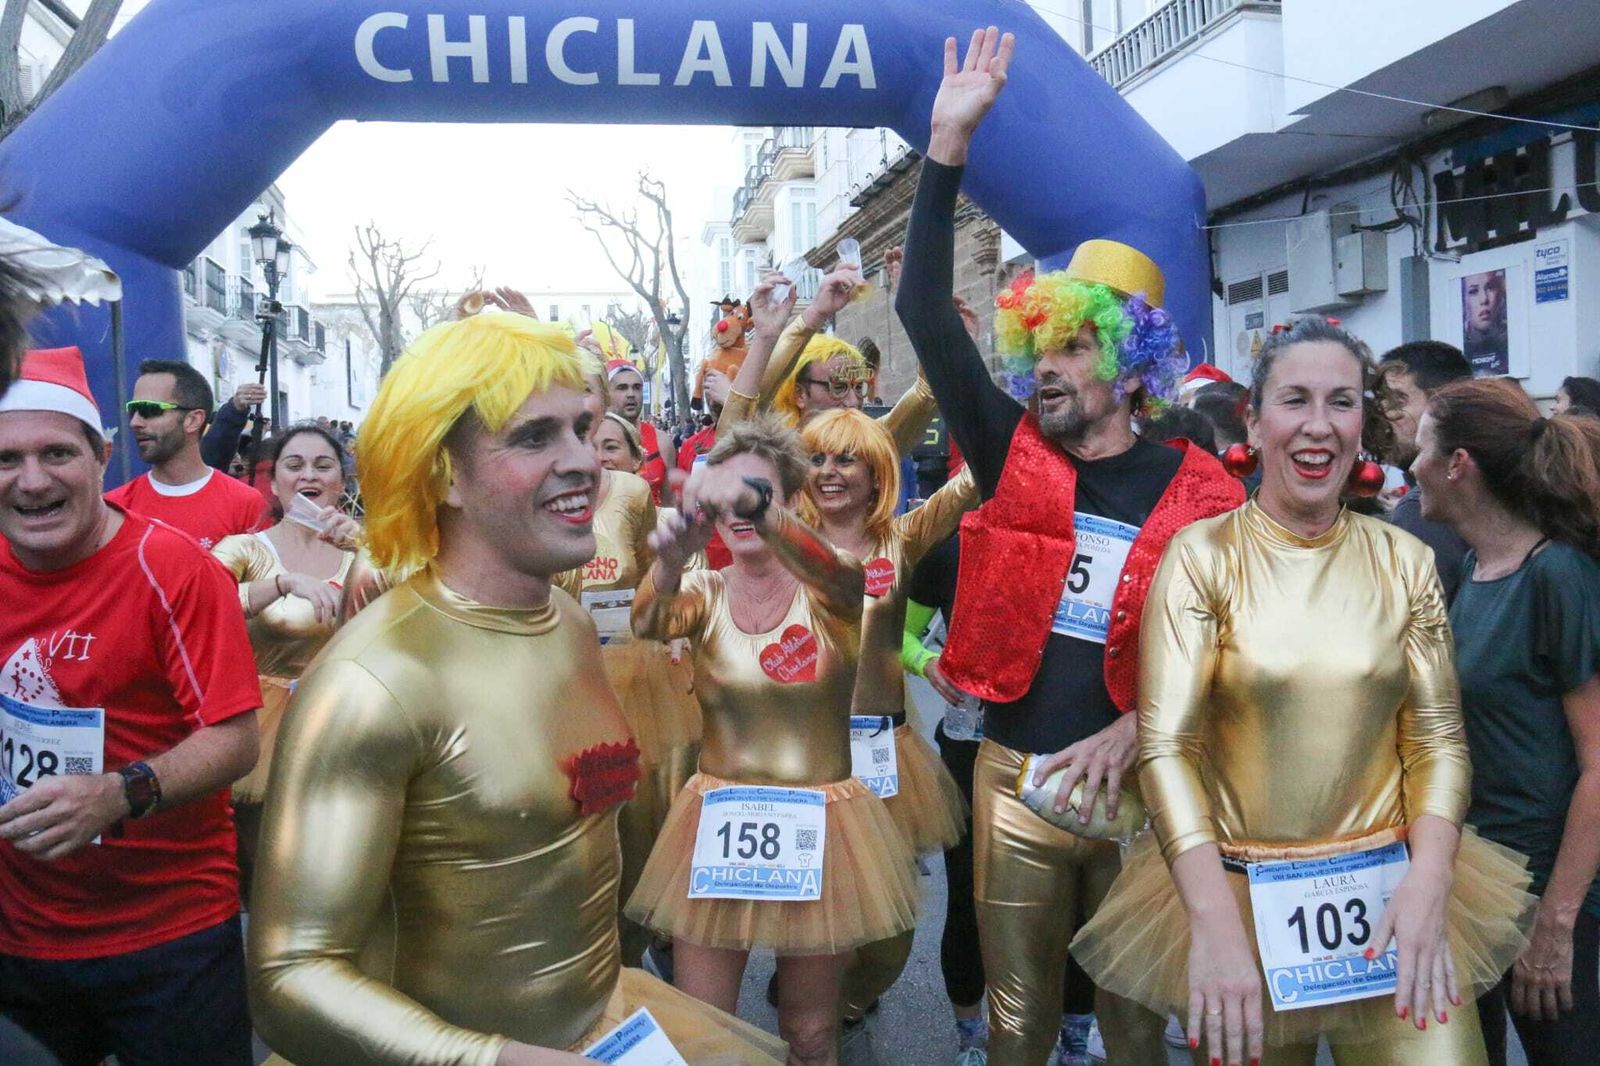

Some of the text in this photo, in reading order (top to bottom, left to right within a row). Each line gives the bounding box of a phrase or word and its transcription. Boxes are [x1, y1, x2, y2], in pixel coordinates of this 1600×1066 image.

[354, 11, 877, 89] CHICLANA
[1536, 247, 1560, 259] tyco
[1067, 553, 1093, 594] 5
[49, 629, 97, 660] VII
[741, 802, 777, 812] ISABEL
[717, 821, 781, 861] 158
[693, 867, 819, 896] CHICLANA
[1313, 874, 1357, 890] LAURA
[1287, 898, 1371, 954] 103
